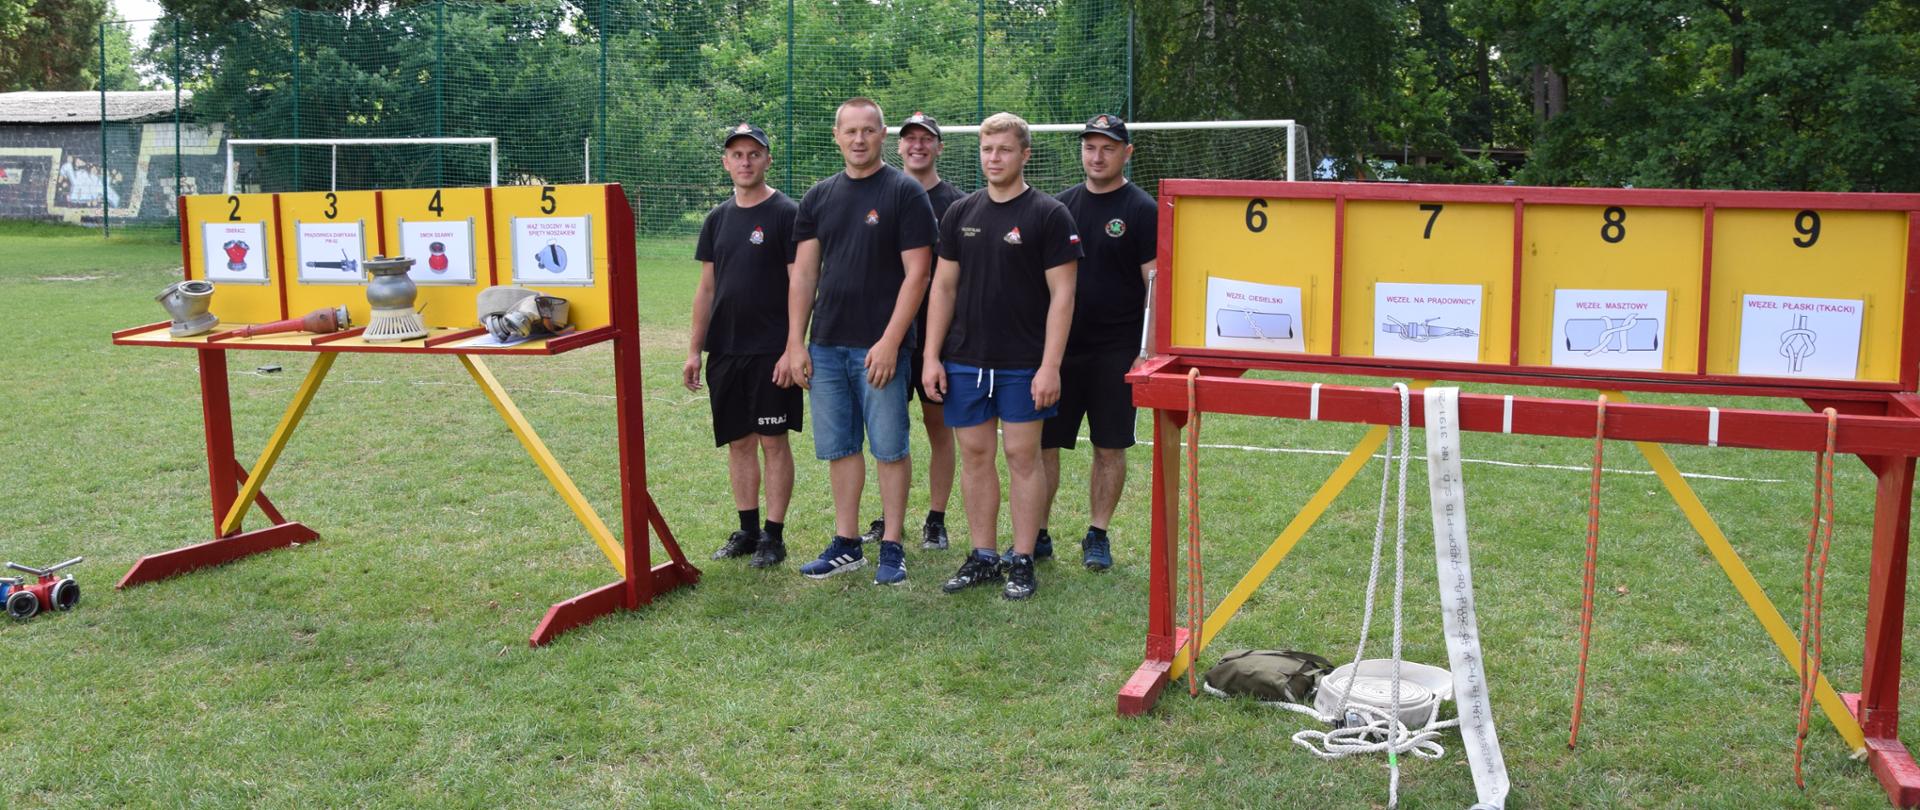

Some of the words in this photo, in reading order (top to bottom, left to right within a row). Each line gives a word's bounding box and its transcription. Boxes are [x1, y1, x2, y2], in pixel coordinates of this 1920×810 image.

[228, 195, 241, 221] 2
[324, 193, 338, 219] 3
[428, 190, 444, 217] 4
[541, 187, 556, 215] 5
[1245, 198, 1268, 233] 6
[1420, 204, 1443, 239] 7
[1601, 207, 1627, 244] 8
[1792, 210, 1821, 248] 9
[1248, 295, 1283, 304] CIESIELSKI
[1386, 296, 1410, 304] WĘZEŁ
[1427, 297, 1476, 306] PRĄDOWNICY
[1576, 302, 1601, 310] WĘZEŁ
[1605, 302, 1648, 310] MASZTOWY
[1748, 300, 1778, 310] WĘZEŁ
[1782, 302, 1814, 311] PŁASKI
[1816, 304, 1855, 314] (TKACKI)
